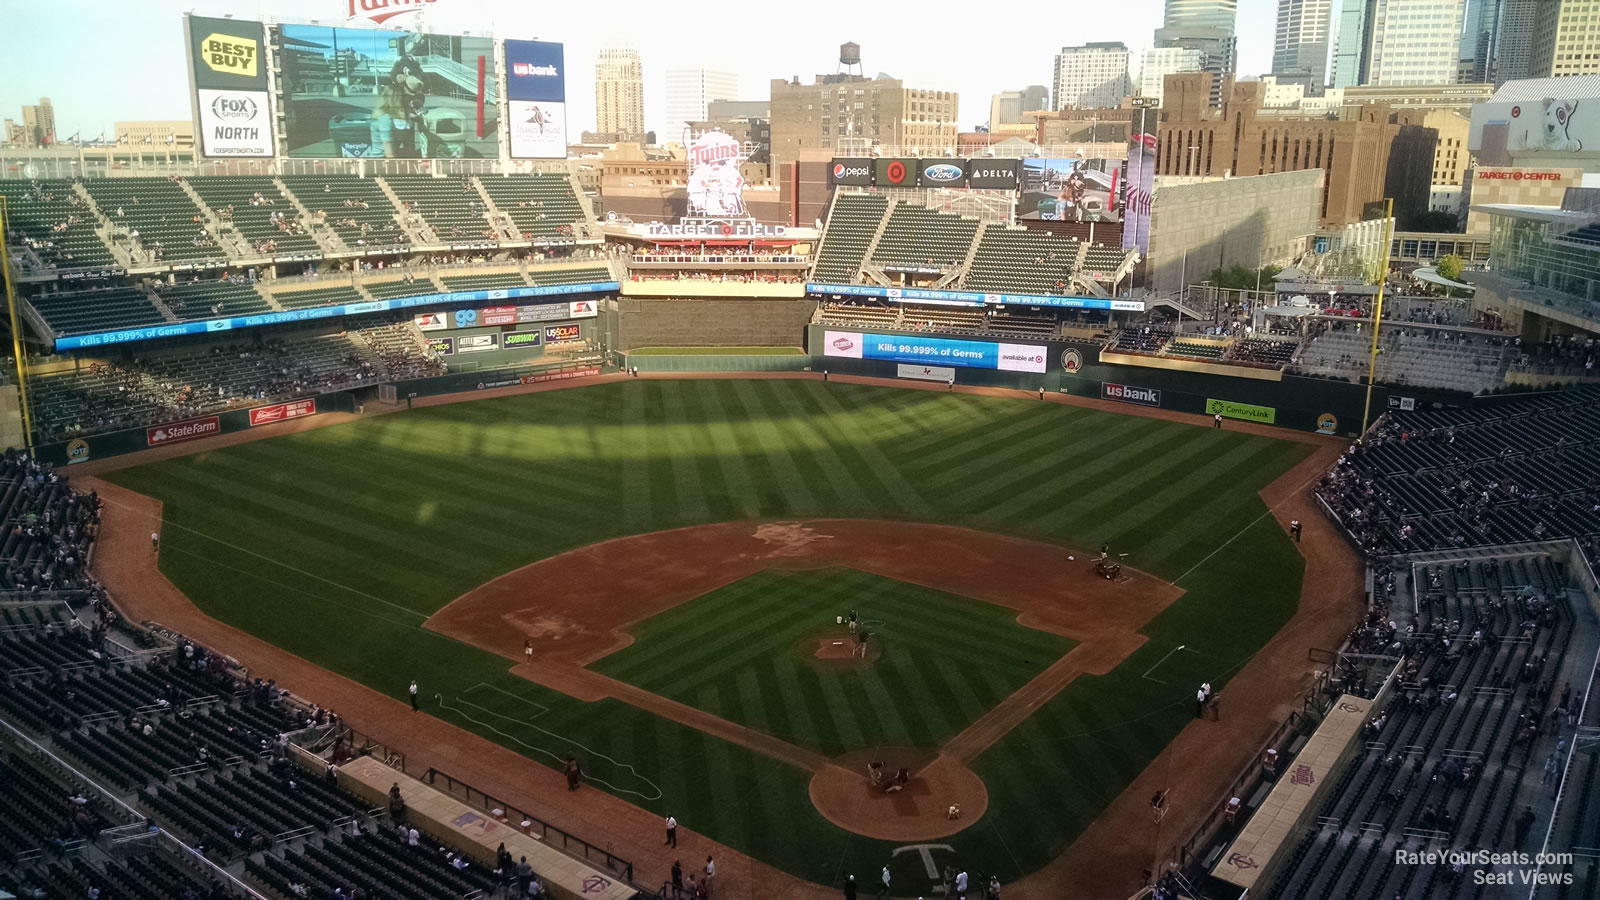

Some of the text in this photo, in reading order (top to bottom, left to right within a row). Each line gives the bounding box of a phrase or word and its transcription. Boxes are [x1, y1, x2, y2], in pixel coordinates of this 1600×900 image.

[209, 40, 255, 58] BEST
[211, 53, 252, 69] BUY
[221, 98, 248, 112] FOX
[215, 126, 259, 140] NORTH
[690, 143, 738, 165] Twins
[846, 166, 869, 177] pepsi
[931, 166, 954, 179] Ford
[983, 169, 1014, 178] DELTA
[1479, 171, 1561, 181] TARGET CENTER
[649, 225, 786, 236] TARGET FIELD
[245, 317, 263, 326] Kills
[300, 311, 308, 319] of
[309, 308, 333, 318] Germs
[80, 327, 187, 346] Kills 99.999% of Germs
[505, 332, 539, 344] SUBWAY
[878, 343, 897, 352] Kills
[898, 345, 939, 356] 99.999%
[940, 348, 951, 356] of
[1002, 354, 1027, 362] available
[1106, 385, 1158, 402] usbank
[1226, 405, 1269, 419] CenturyLink
[70, 447, 87, 455] VOTE
